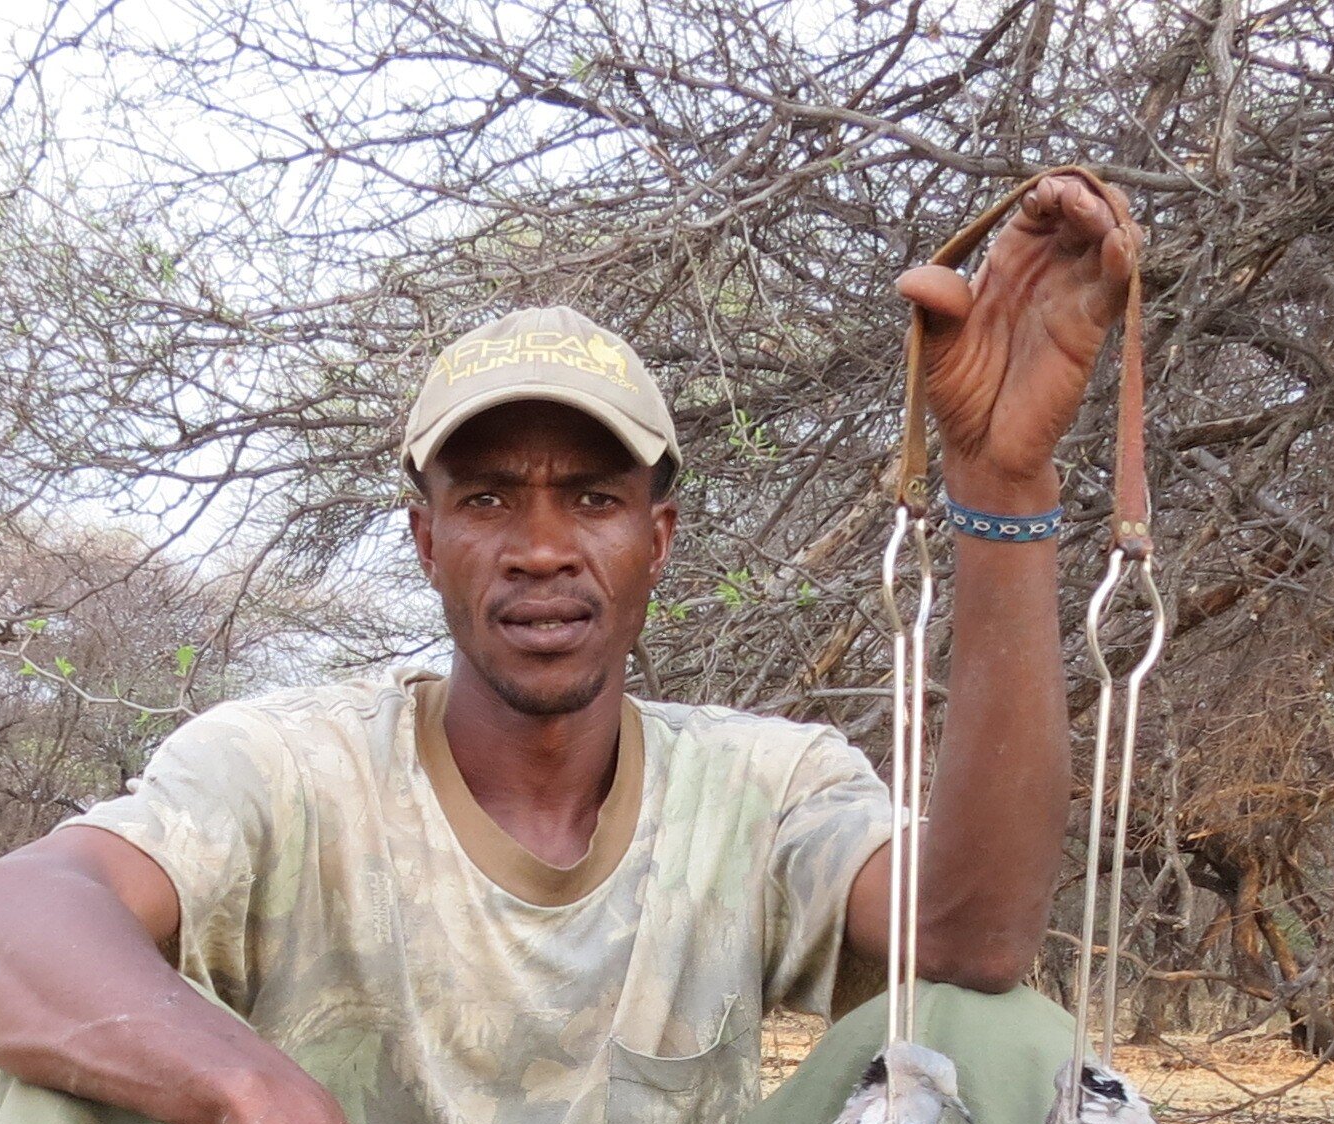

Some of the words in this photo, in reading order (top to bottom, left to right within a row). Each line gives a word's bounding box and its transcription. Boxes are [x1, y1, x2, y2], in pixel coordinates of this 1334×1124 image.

[430, 331, 589, 381] AFRICA
[447, 350, 608, 386] HUNTING
[605, 374, 640, 395] .com
